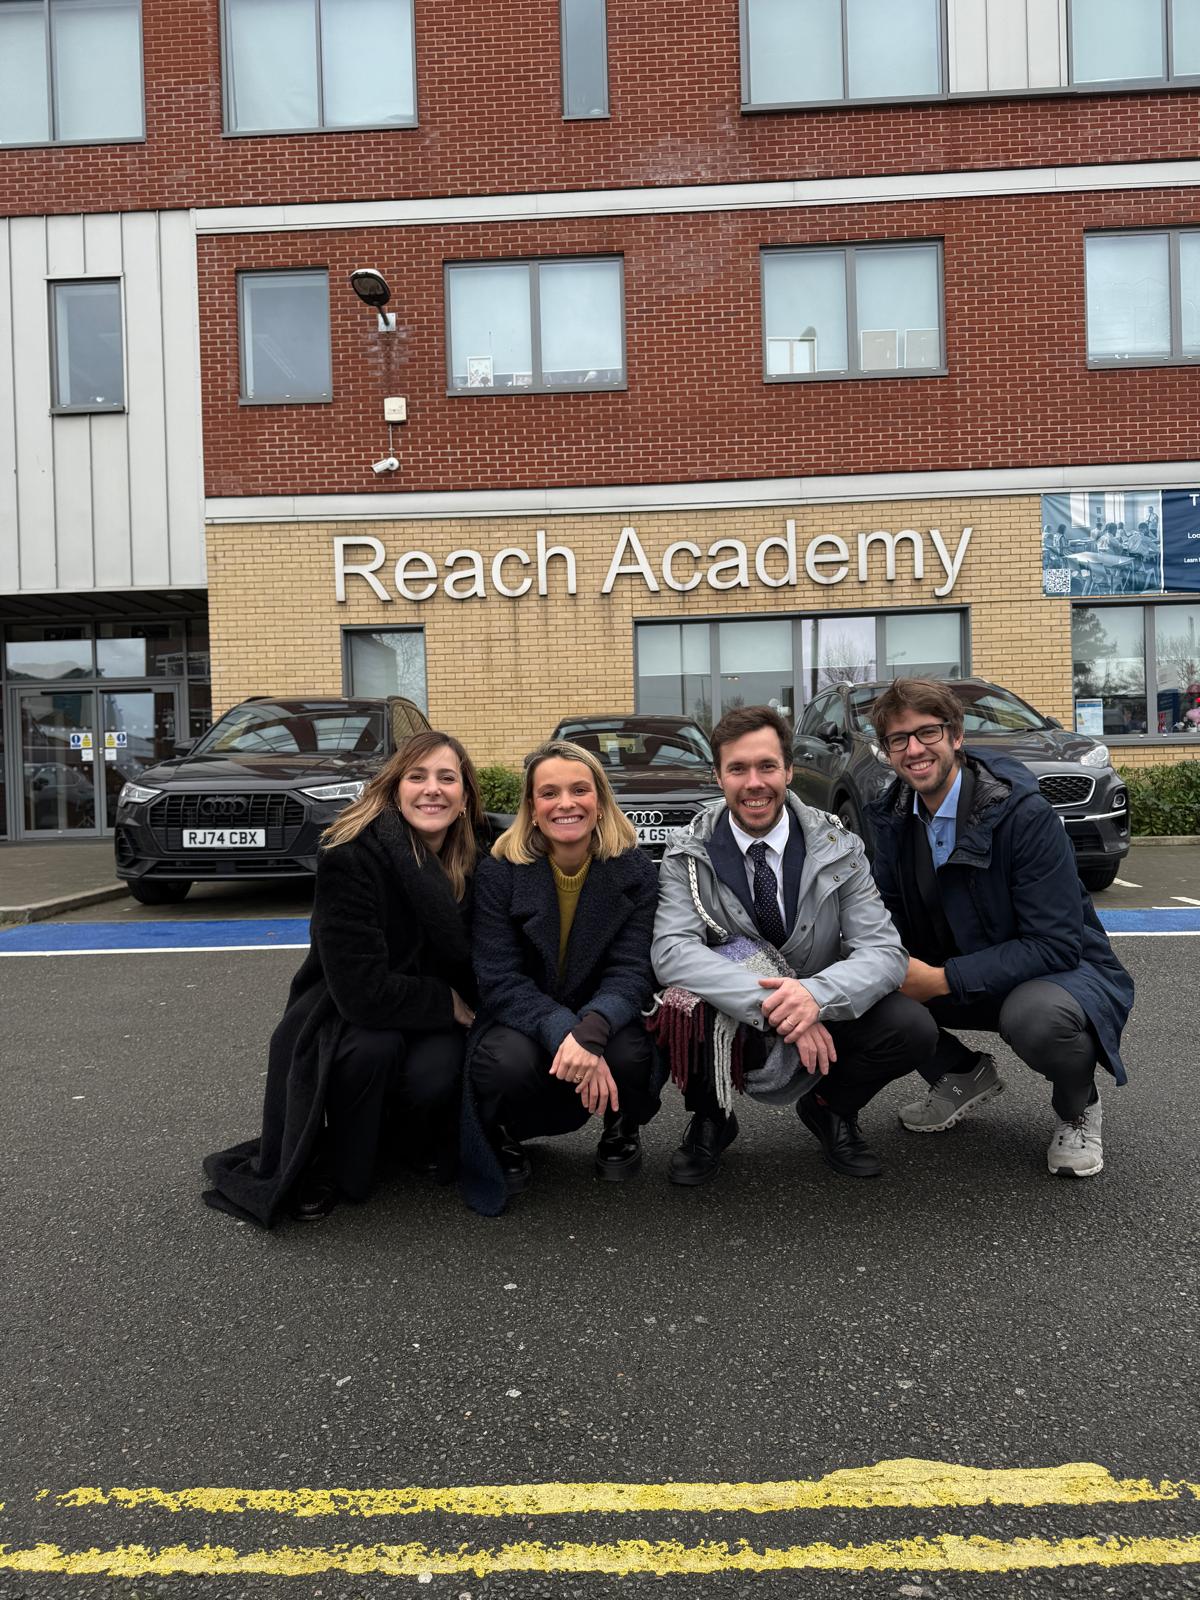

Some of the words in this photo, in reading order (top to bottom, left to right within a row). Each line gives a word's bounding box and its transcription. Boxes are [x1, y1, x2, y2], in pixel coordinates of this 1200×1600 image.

[332, 529, 577, 603] Reach
[601, 519, 974, 597] Academy
[188, 831, 226, 845] RJ74
[229, 831, 258, 845] CBX
